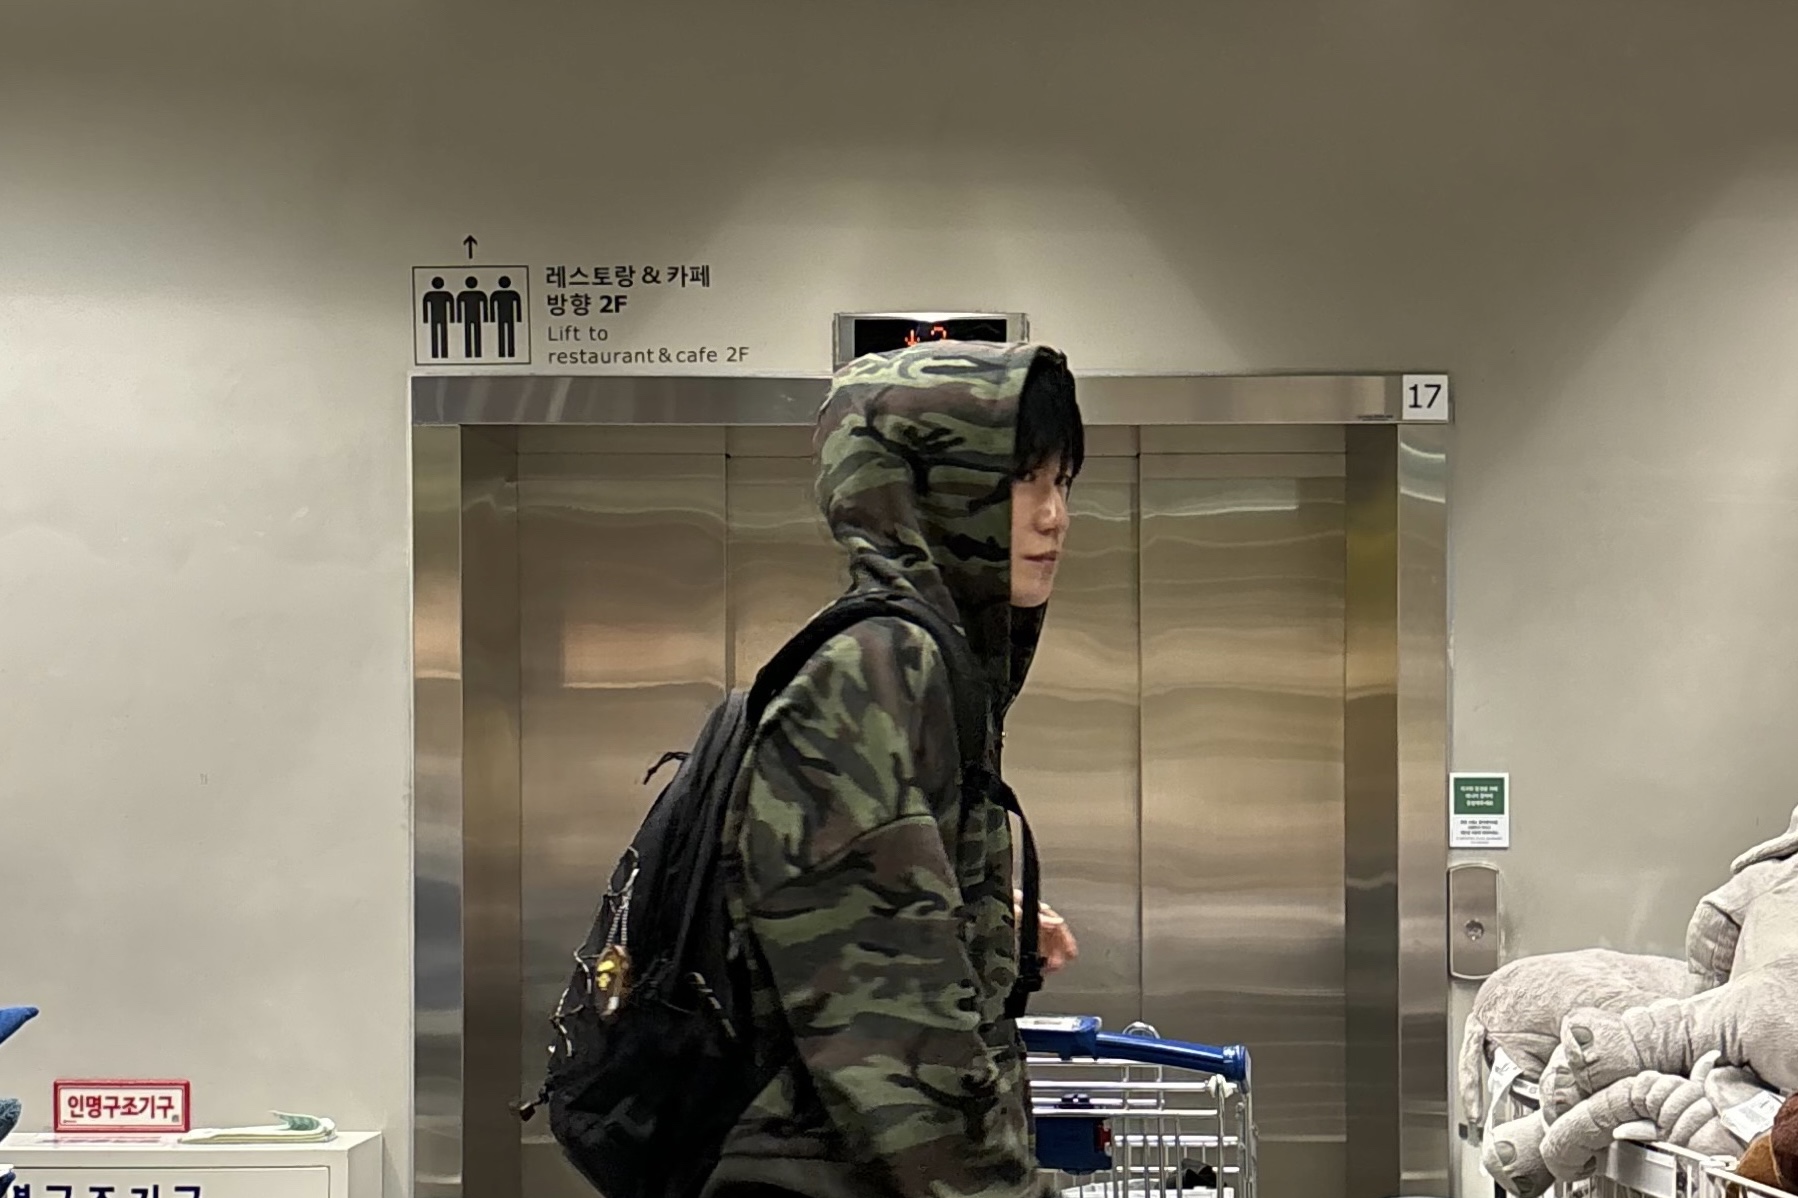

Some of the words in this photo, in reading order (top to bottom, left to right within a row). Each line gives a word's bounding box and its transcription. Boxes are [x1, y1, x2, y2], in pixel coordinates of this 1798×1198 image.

[546, 265, 636, 288] 레스토랑
[641, 266, 661, 285] &
[667, 264, 710, 287] 카페
[547, 293, 591, 316] 방향
[600, 295, 628, 314] 2F
[548, 325, 581, 341] Lift
[589, 327, 608, 341] to
[726, 347, 749, 362] 2F
[1408, 384, 1442, 409] 17
[67, 1095, 175, 1119] 인명구조기구
